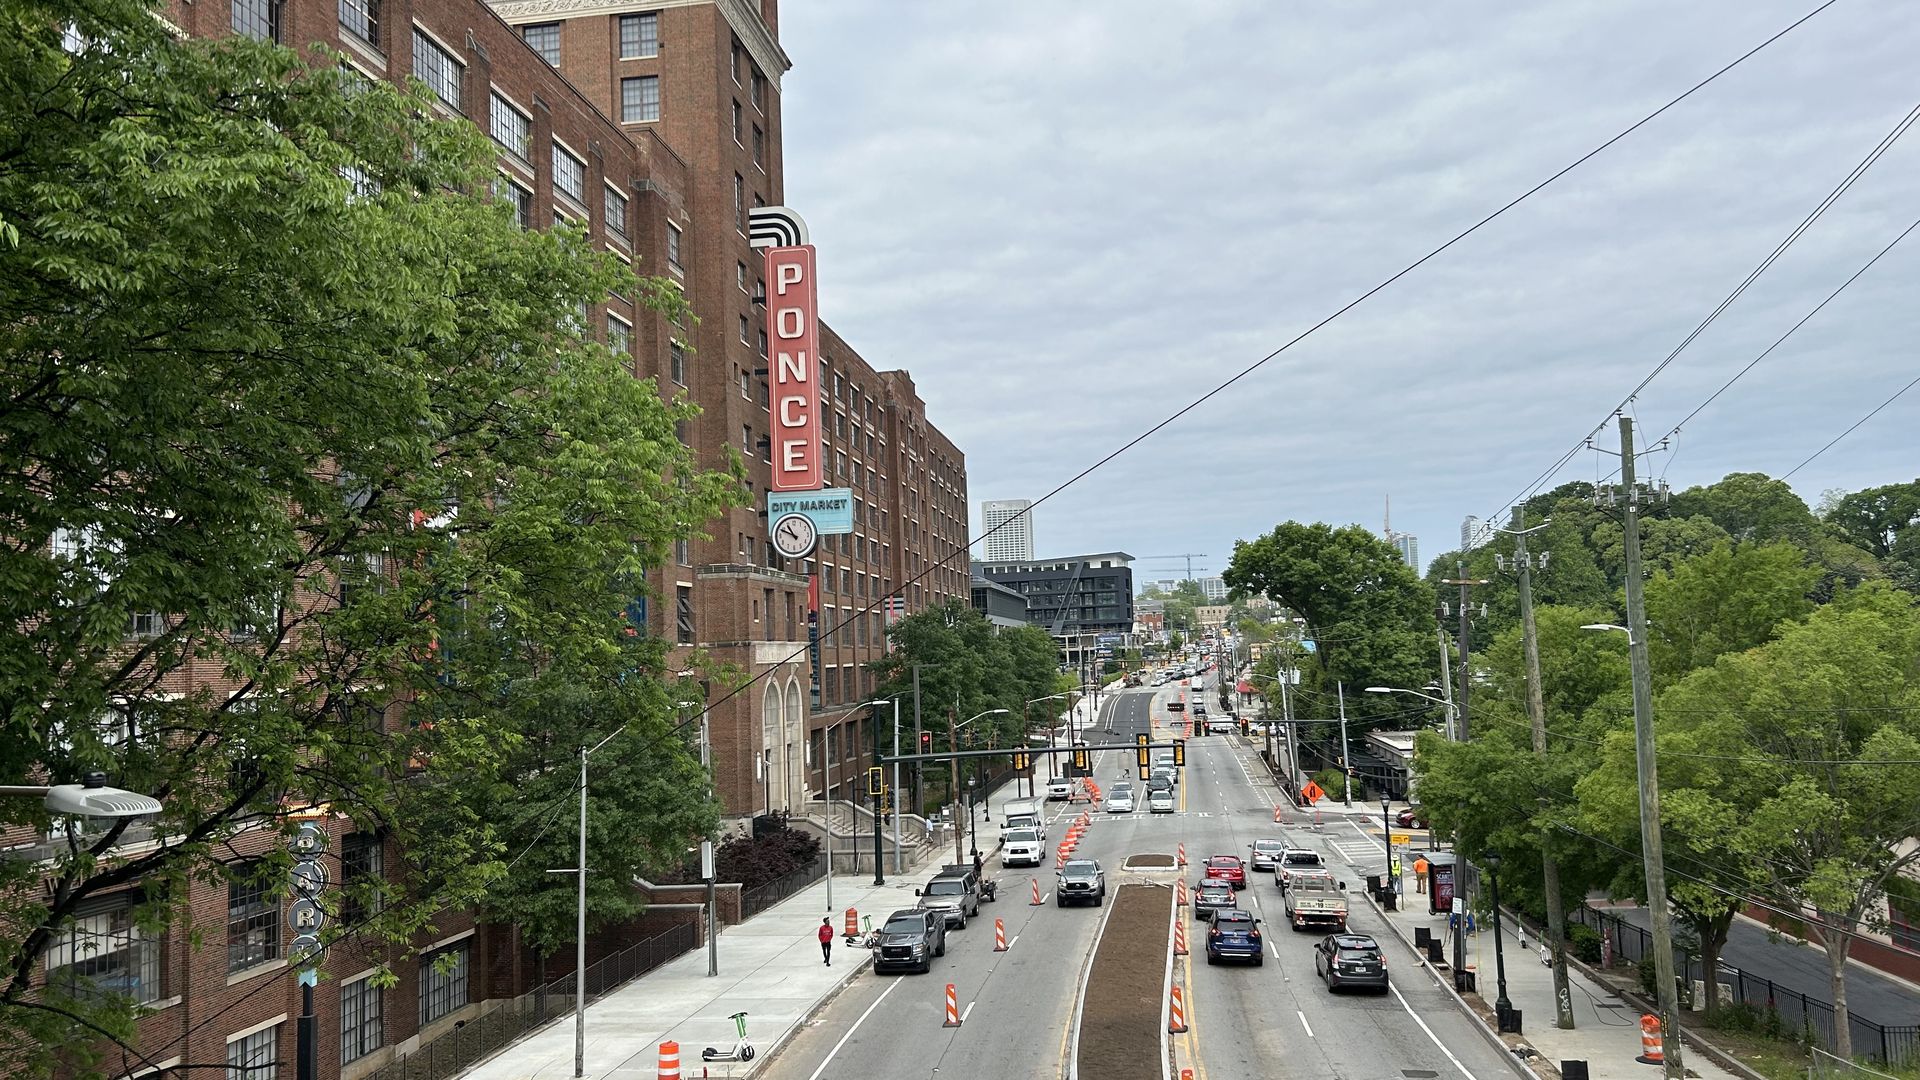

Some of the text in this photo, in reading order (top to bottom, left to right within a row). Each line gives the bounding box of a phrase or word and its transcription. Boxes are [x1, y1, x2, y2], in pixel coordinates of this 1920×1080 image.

[776, 263, 809, 472] PONCE
[771, 499, 847, 512] CITY MARKET
